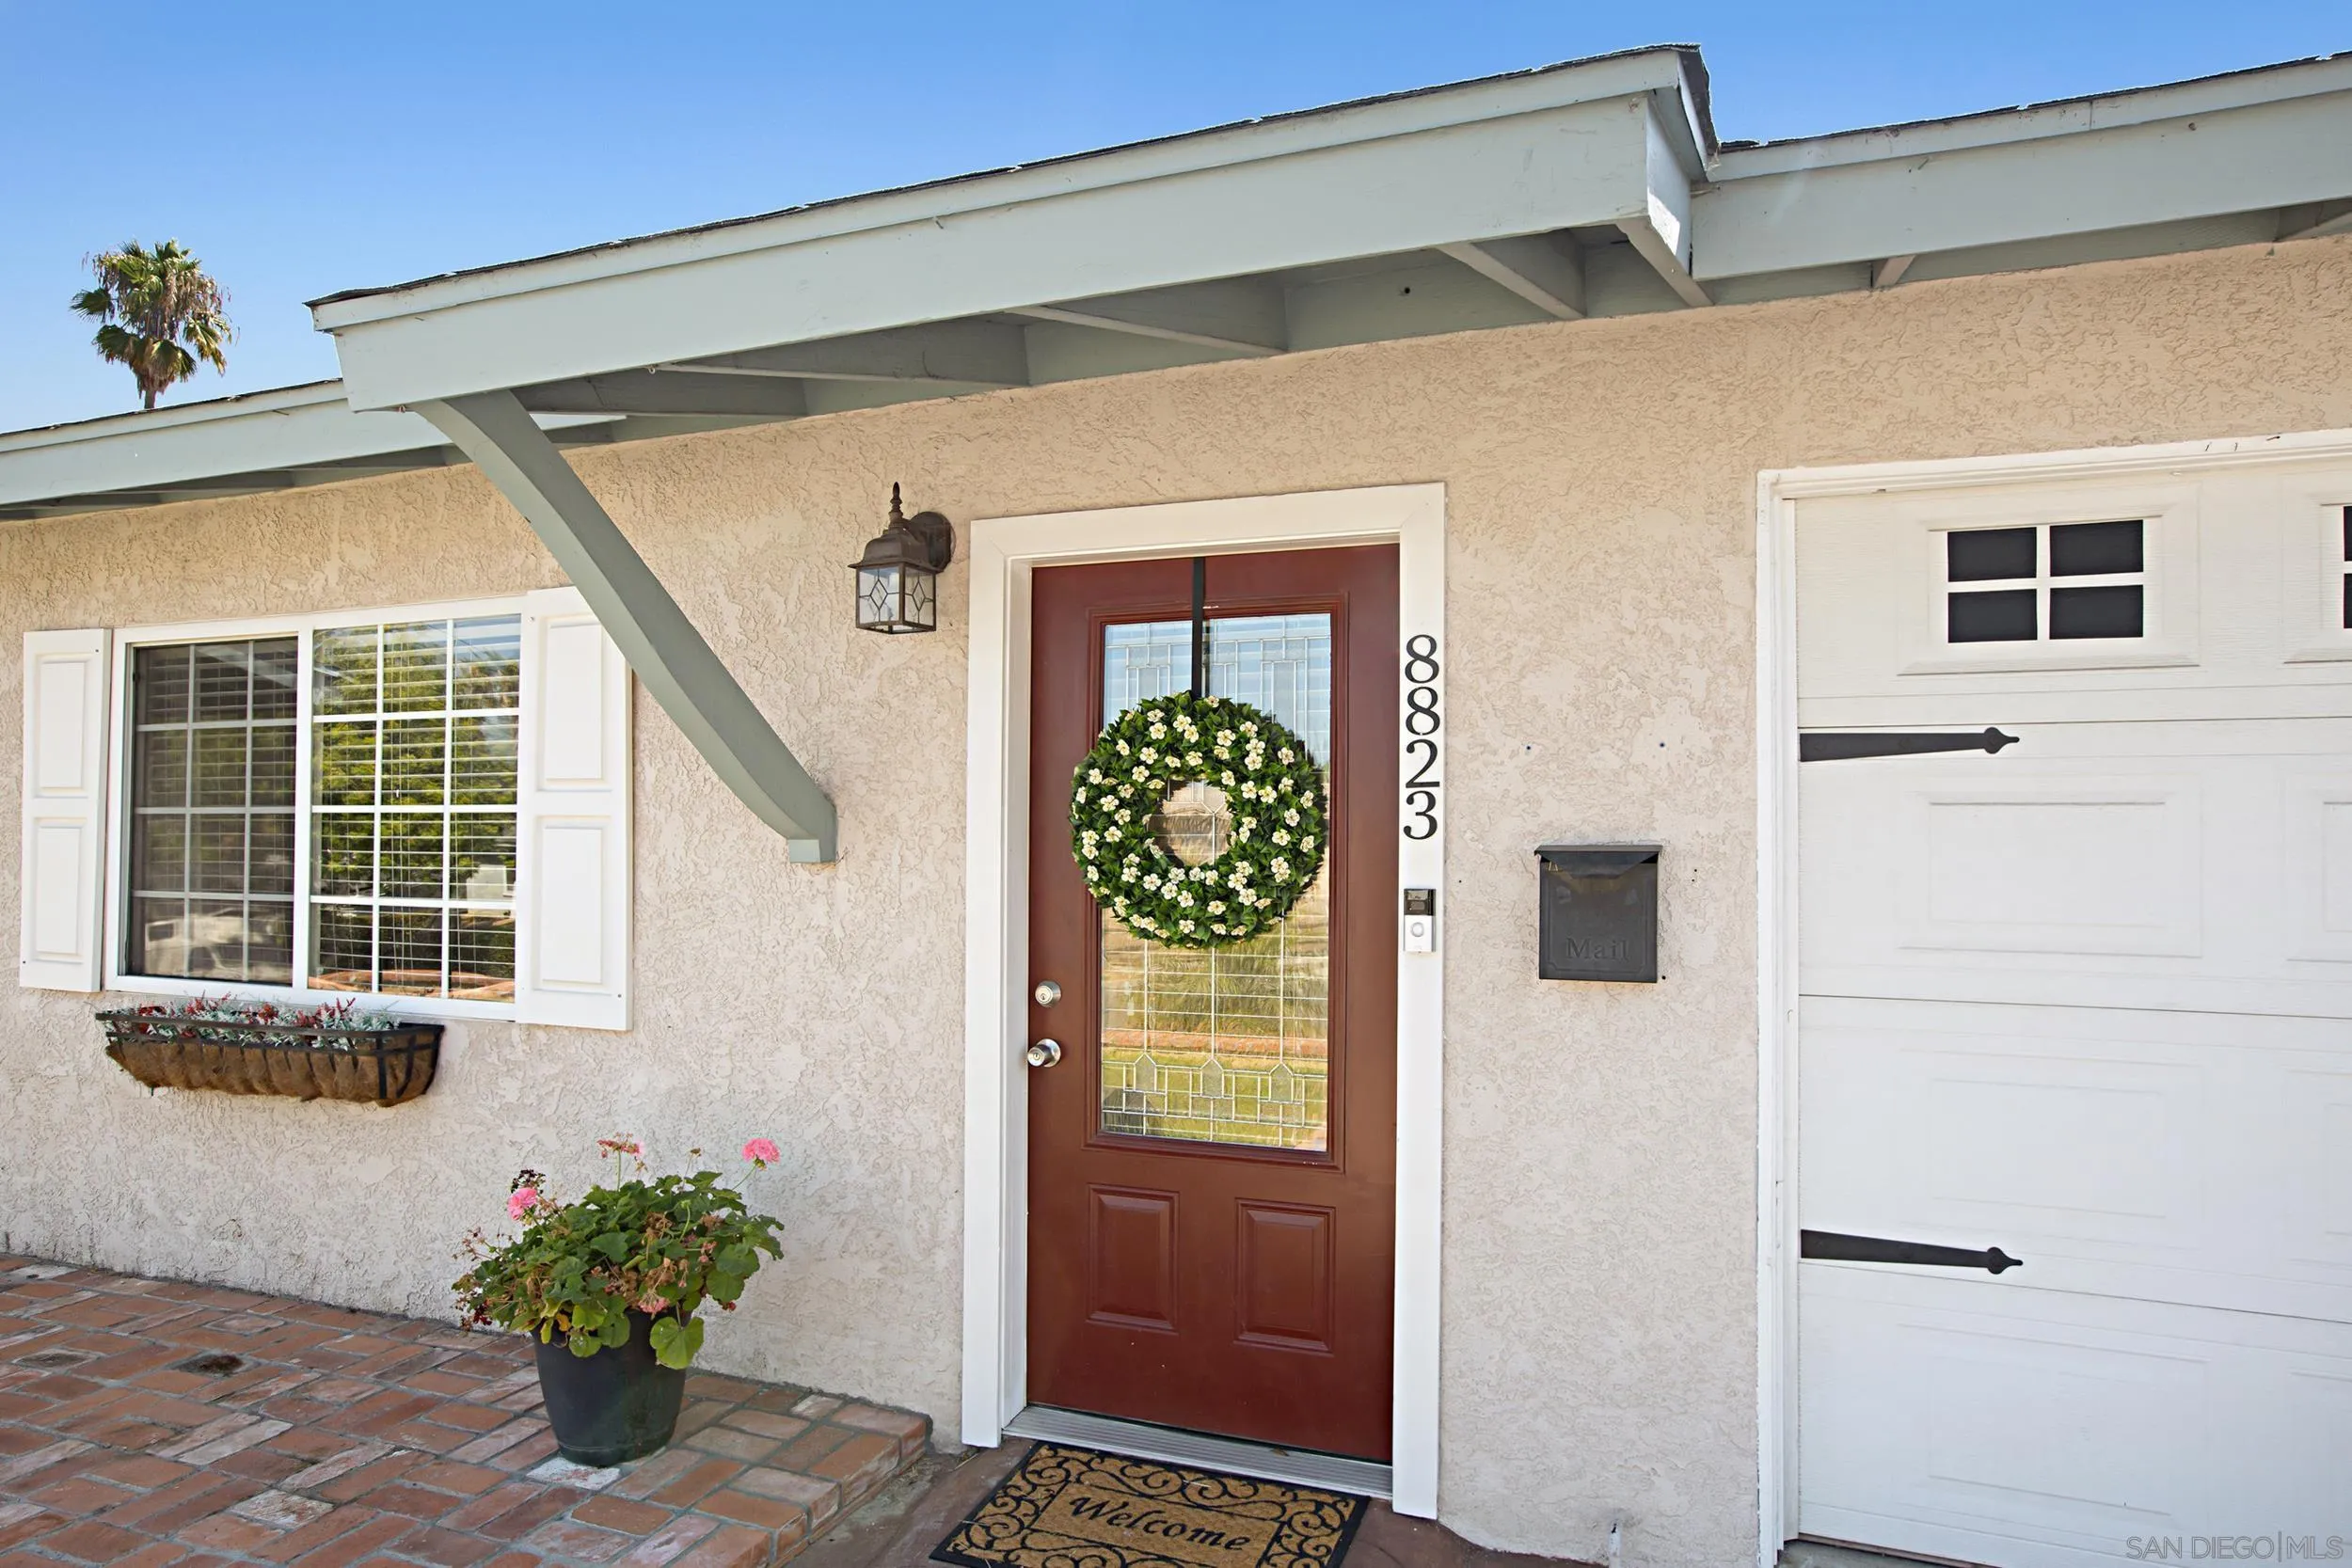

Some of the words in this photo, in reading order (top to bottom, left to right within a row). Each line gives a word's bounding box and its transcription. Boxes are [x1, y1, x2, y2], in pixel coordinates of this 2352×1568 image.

[1404, 634, 1440, 840] 8823
[1565, 937, 1629, 961] Mail
[1068, 1495, 1252, 1551] Welcome
